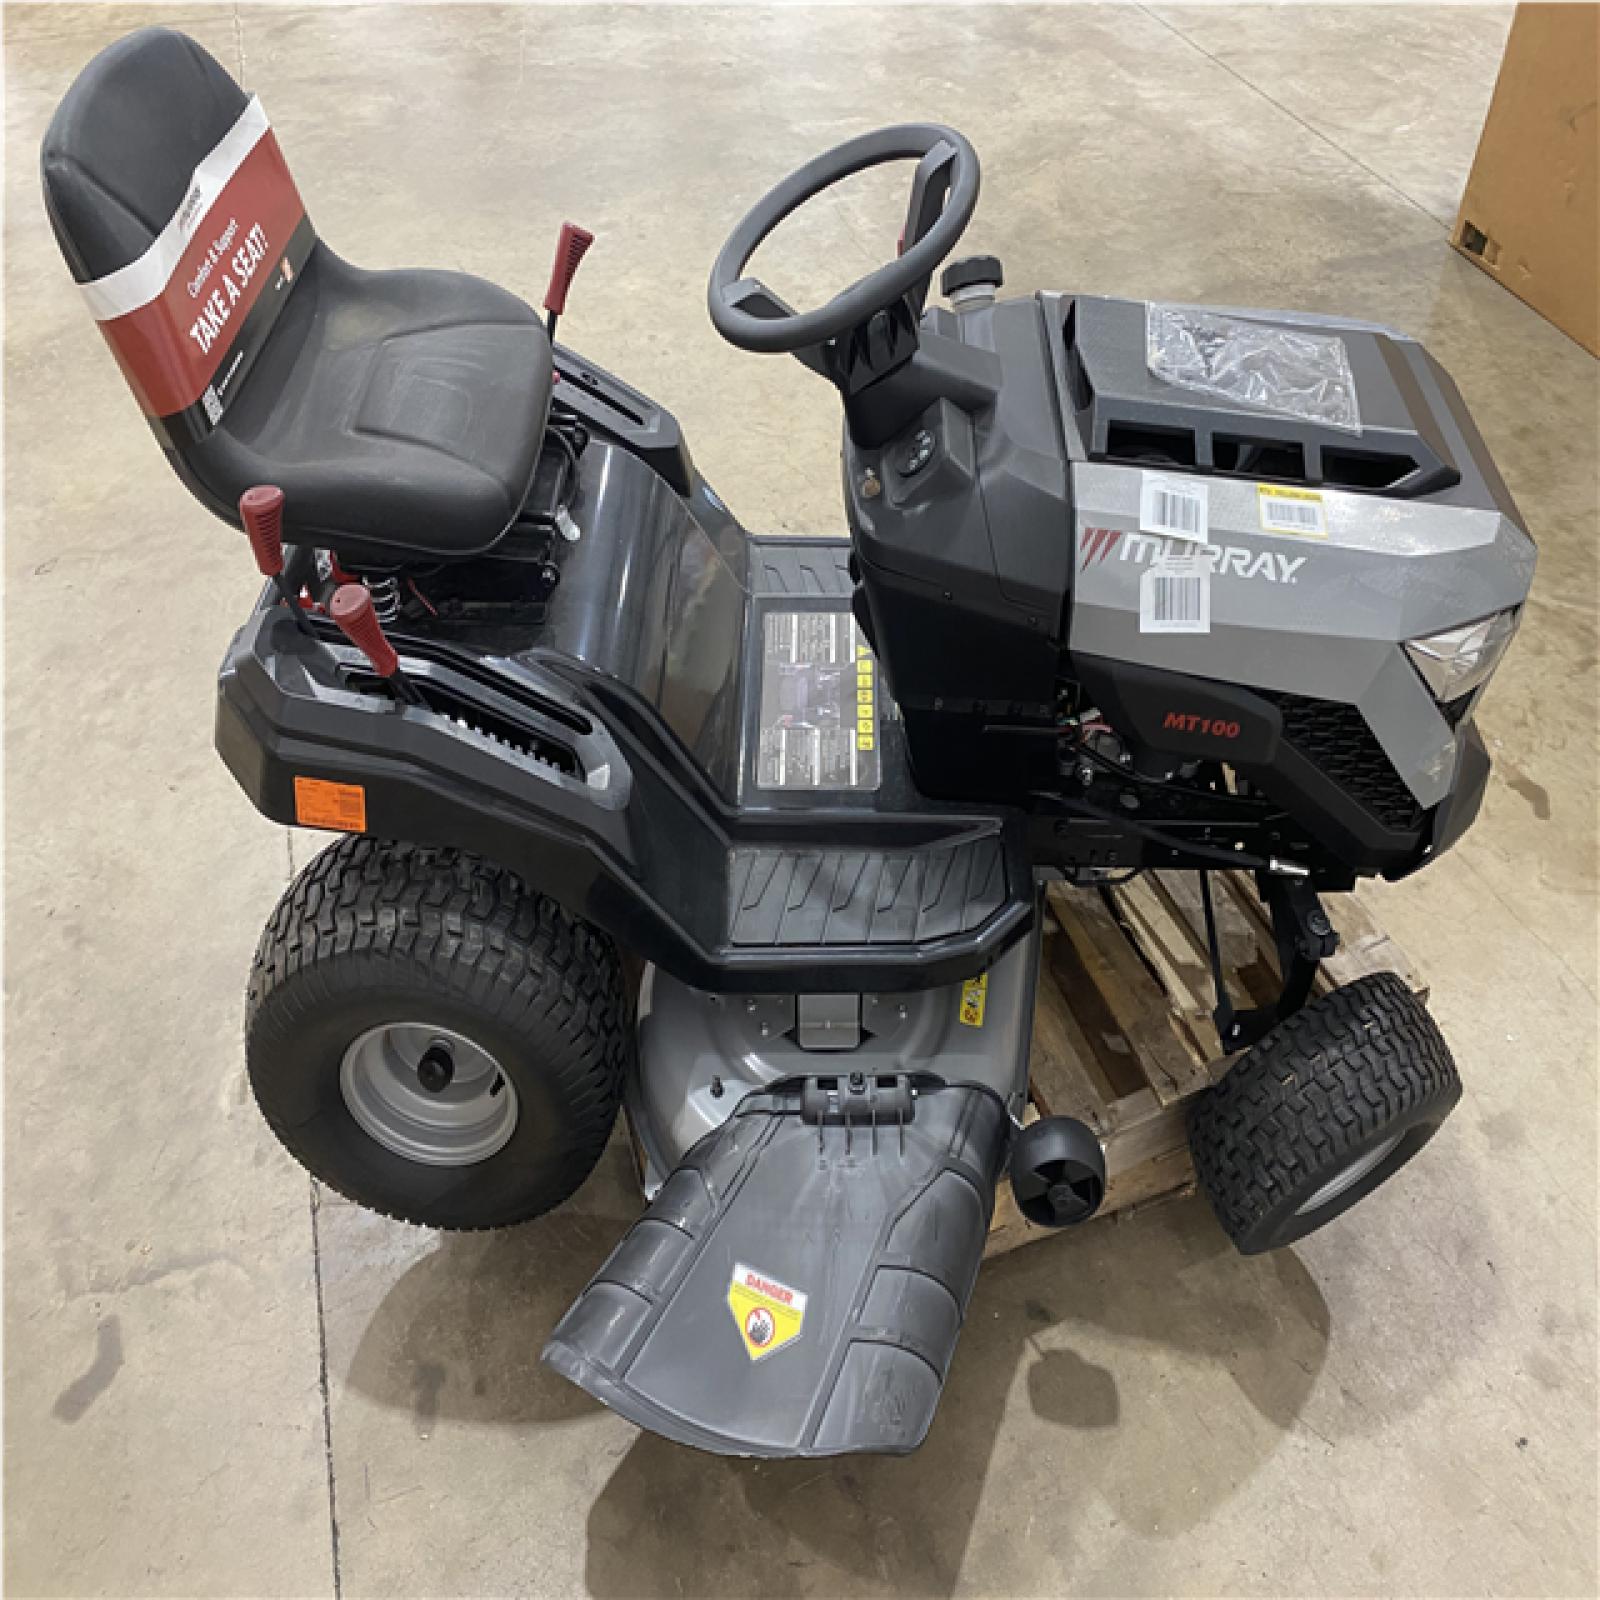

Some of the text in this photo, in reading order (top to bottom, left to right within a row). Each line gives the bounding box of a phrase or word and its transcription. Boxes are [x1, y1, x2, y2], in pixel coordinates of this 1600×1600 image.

[189, 288, 231, 355] TAKE
[221, 273, 241, 306] A
[232, 222, 269, 288] SEAT!
[1163, 711, 1241, 738] MT100
[746, 1272, 793, 1305] DANGER
